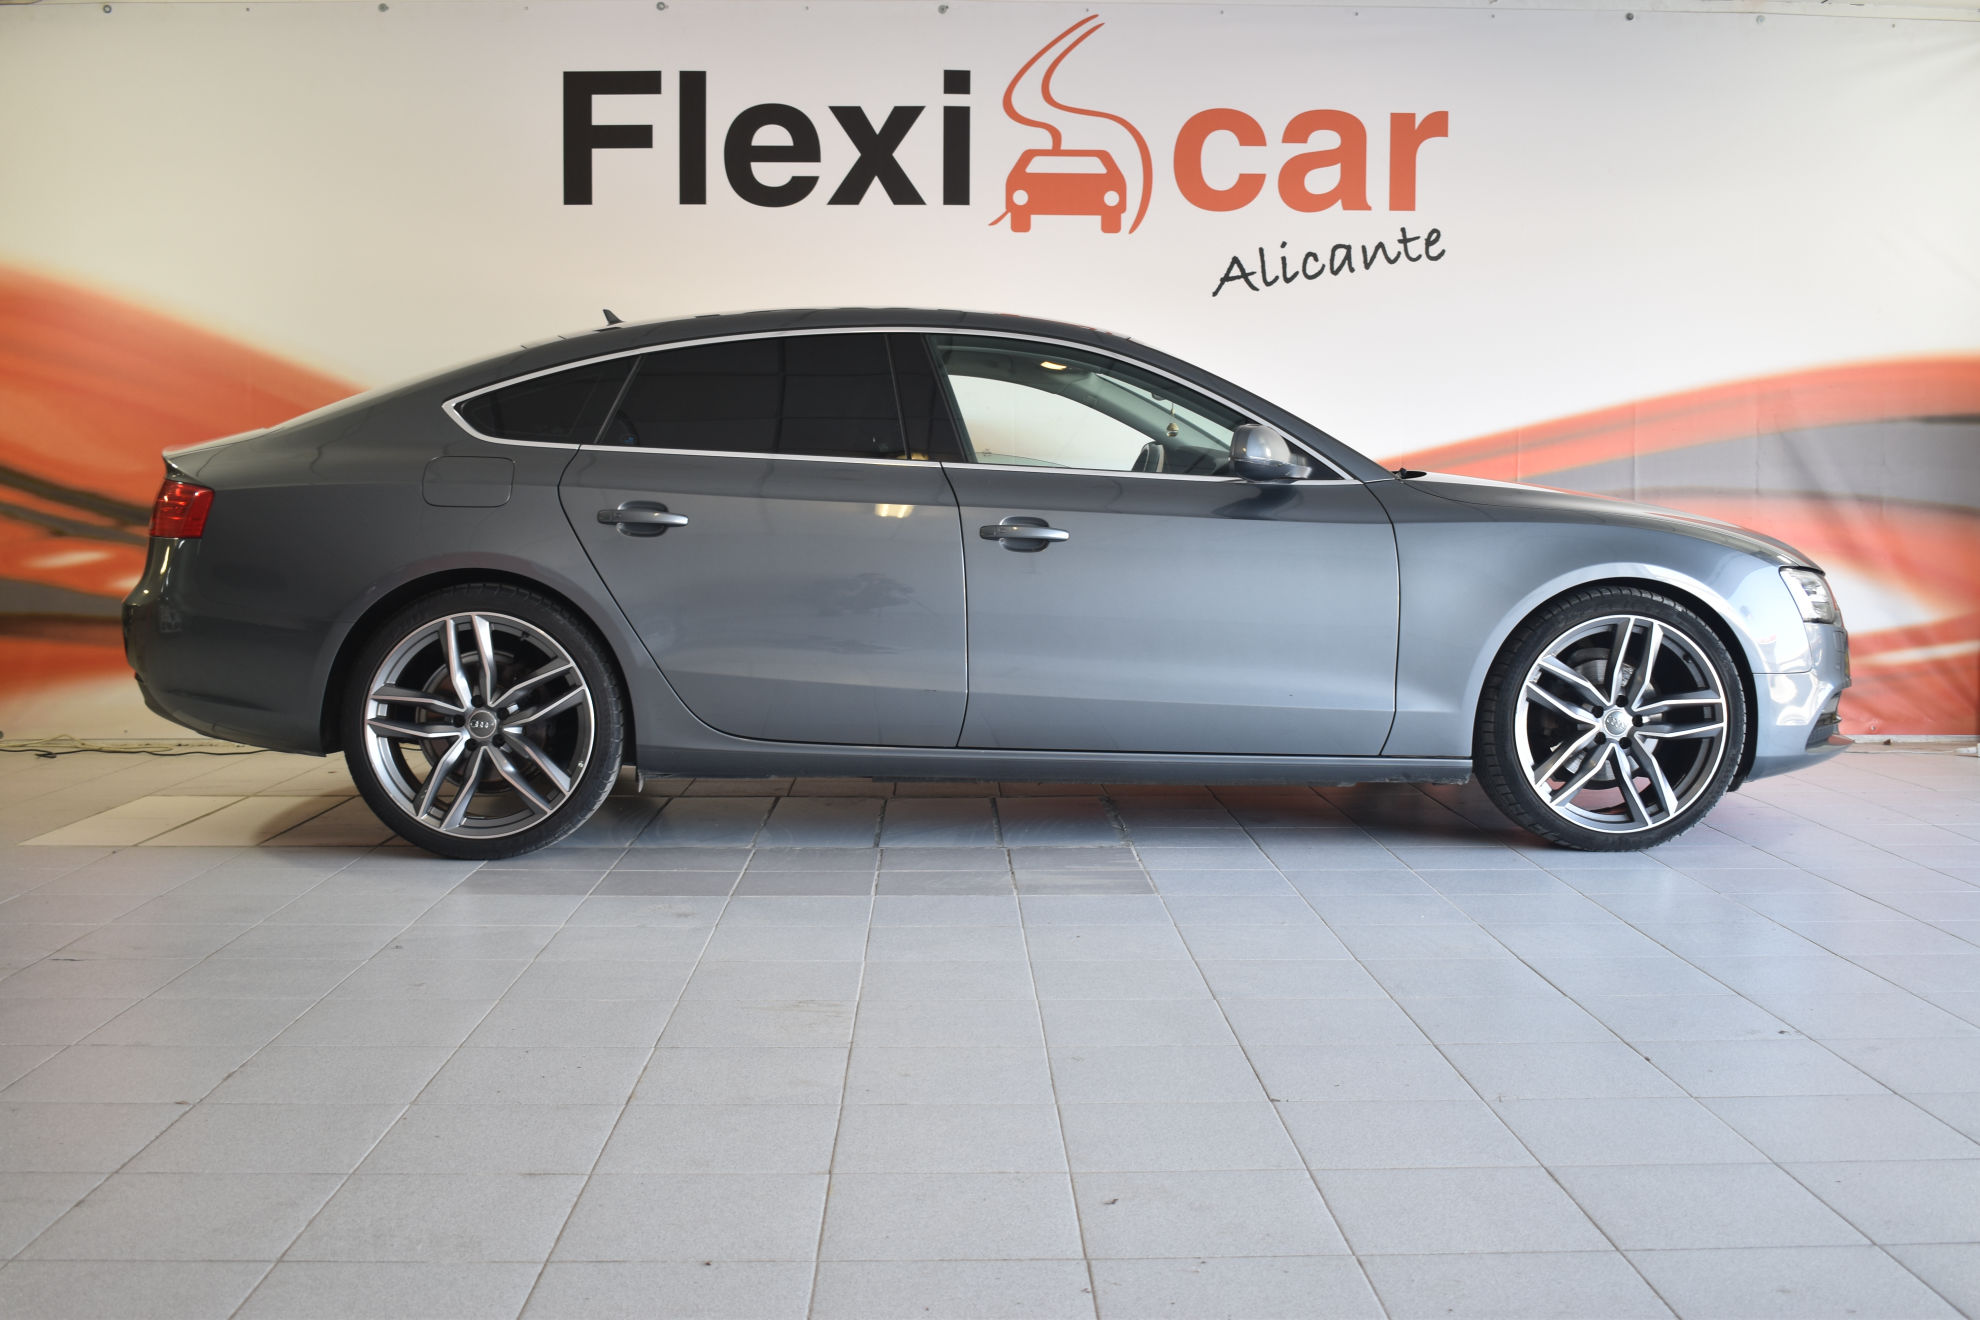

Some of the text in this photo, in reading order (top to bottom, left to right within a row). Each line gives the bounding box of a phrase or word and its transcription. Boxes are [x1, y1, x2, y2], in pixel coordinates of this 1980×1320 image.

[563, 70, 1449, 212] Flexi car
[1212, 226, 1447, 298] Alicante
